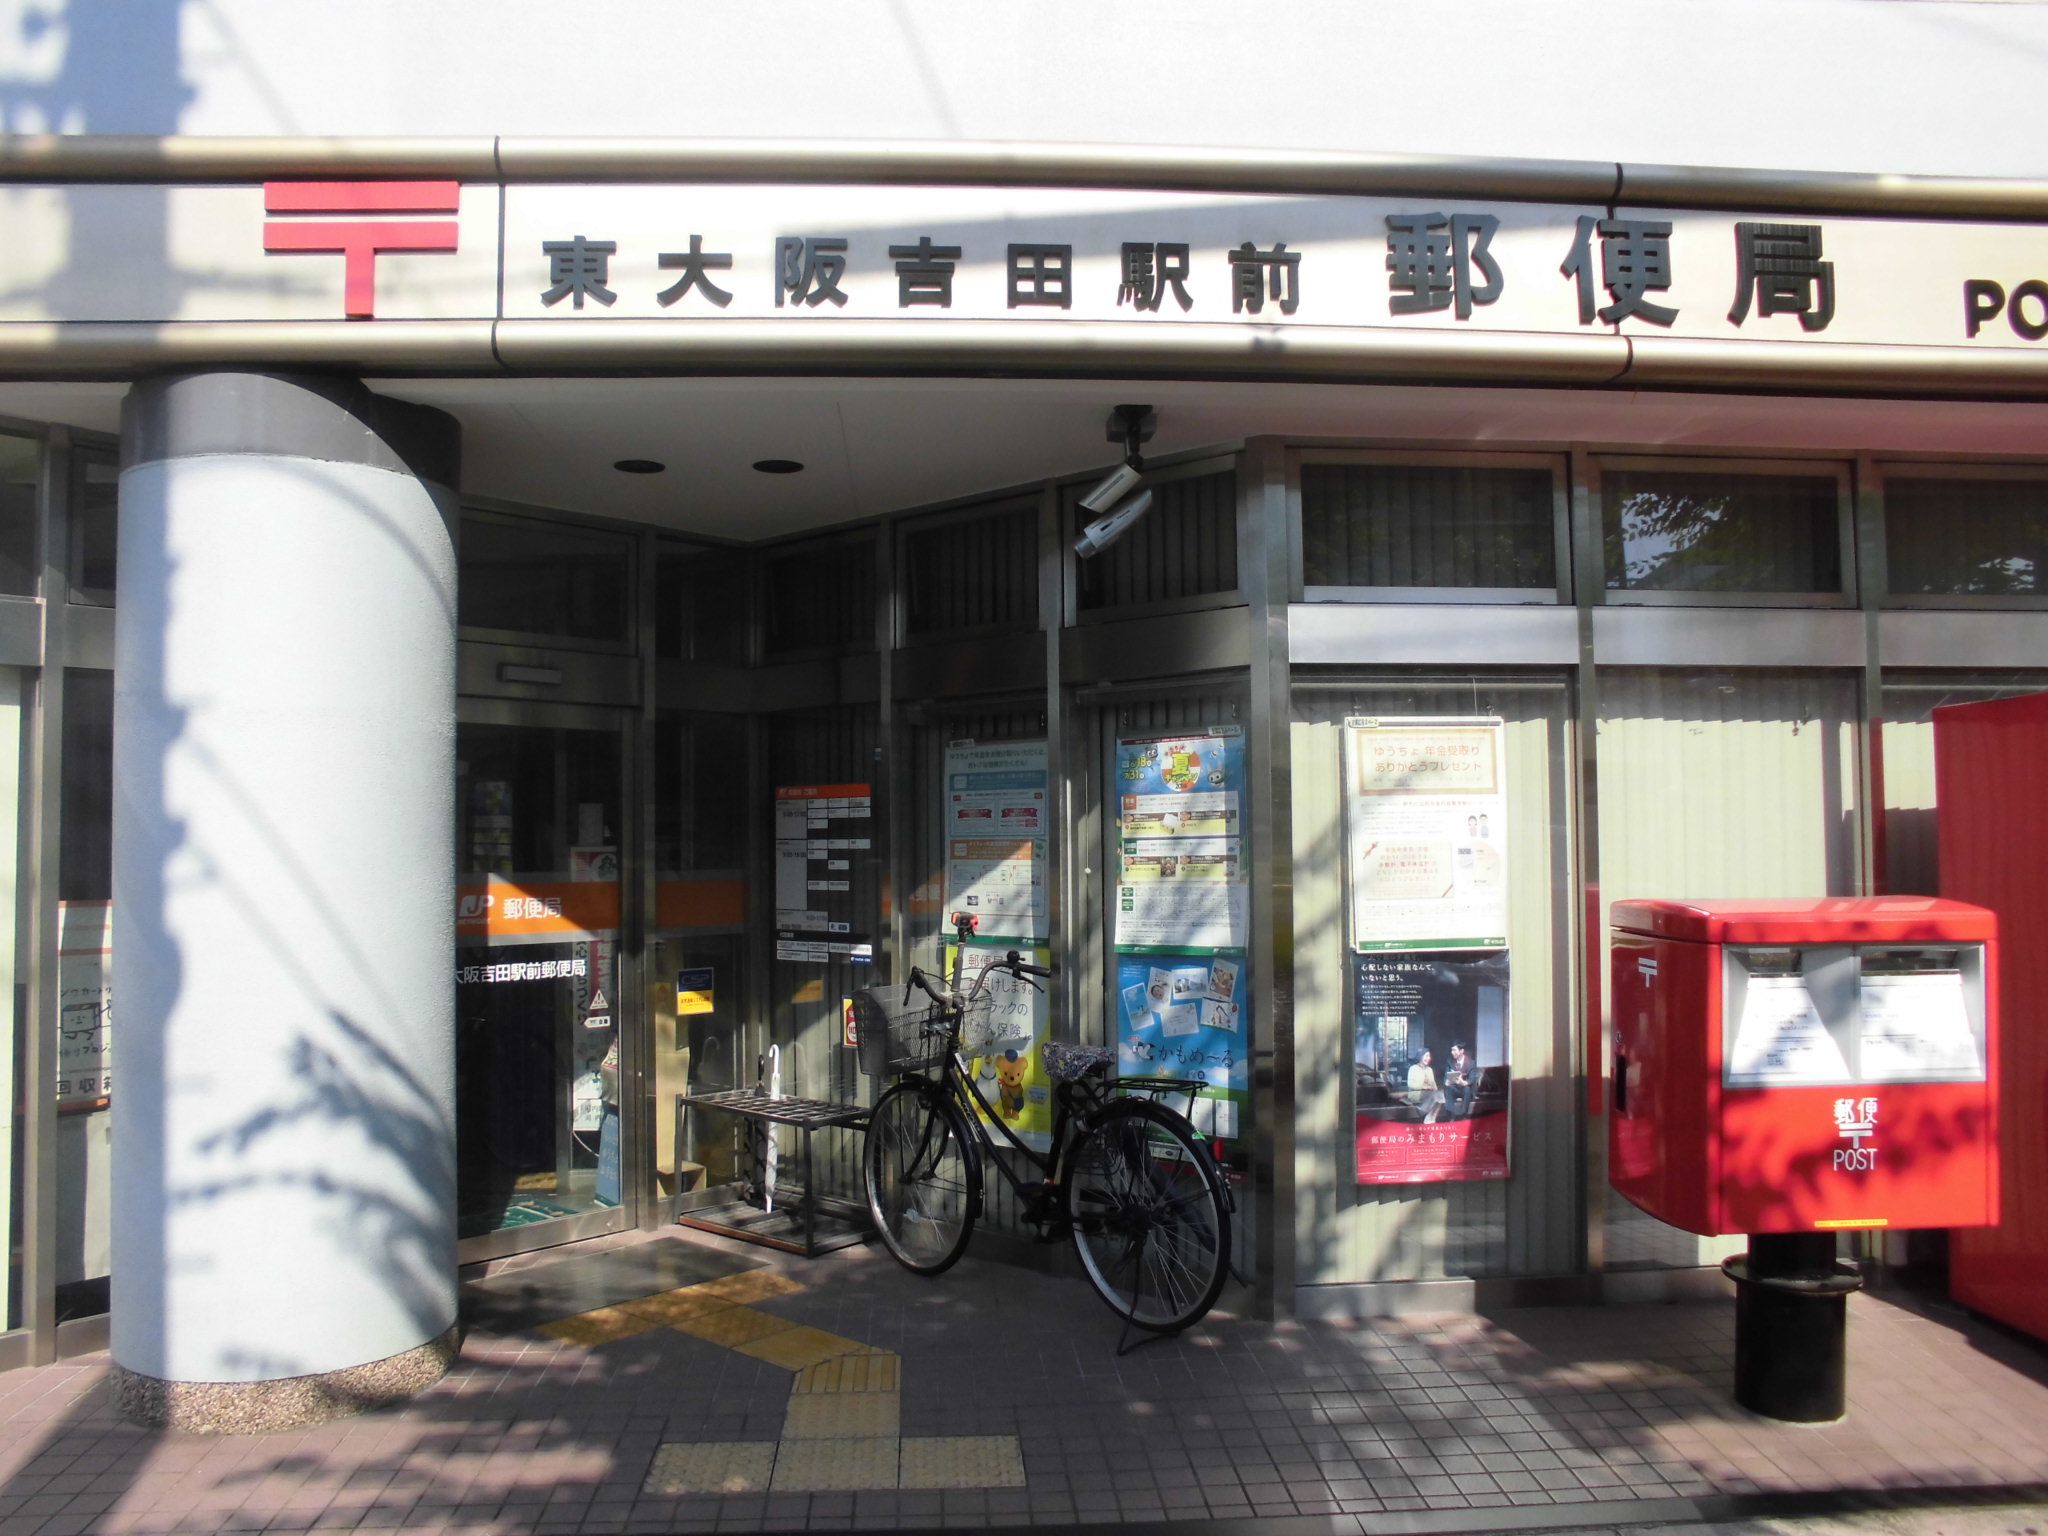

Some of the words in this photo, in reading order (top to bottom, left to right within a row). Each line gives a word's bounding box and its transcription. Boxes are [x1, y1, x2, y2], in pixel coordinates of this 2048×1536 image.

[540, 234, 1303, 316] 東大阪吉田駅前
[1385, 212, 1836, 333] 郵便局
[1375, 761, 1482, 773] ありがとうプレゼント
[503, 898, 562, 920] 郵便局
[969, 976, 1033, 996] 届けします。
[1833, 1097, 1878, 1125] 郵便
[1371, 1132, 1492, 1145] 郵便局のみまもりサービス
[1833, 1148, 1878, 1171] POST
